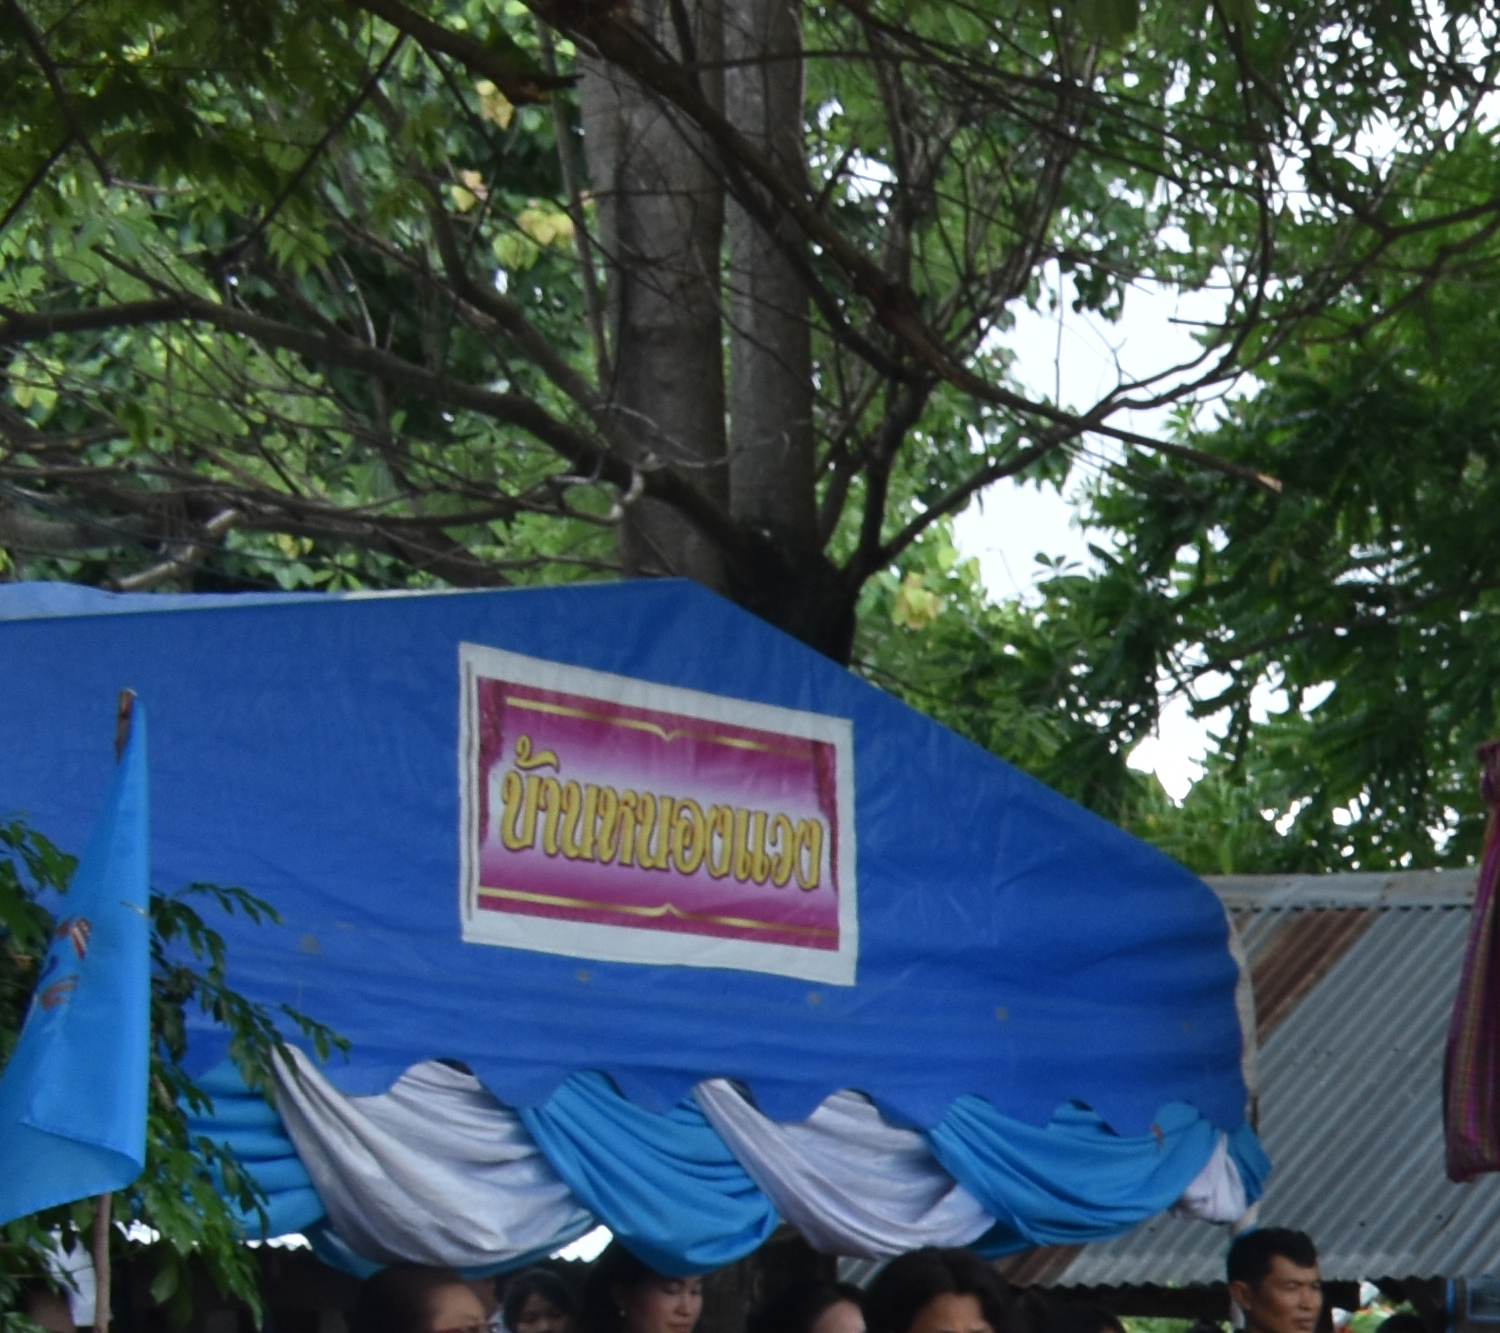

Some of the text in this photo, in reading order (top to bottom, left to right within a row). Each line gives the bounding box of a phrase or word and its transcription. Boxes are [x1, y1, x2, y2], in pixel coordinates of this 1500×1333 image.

[501, 734, 823, 891] บ้านหนองแวง
